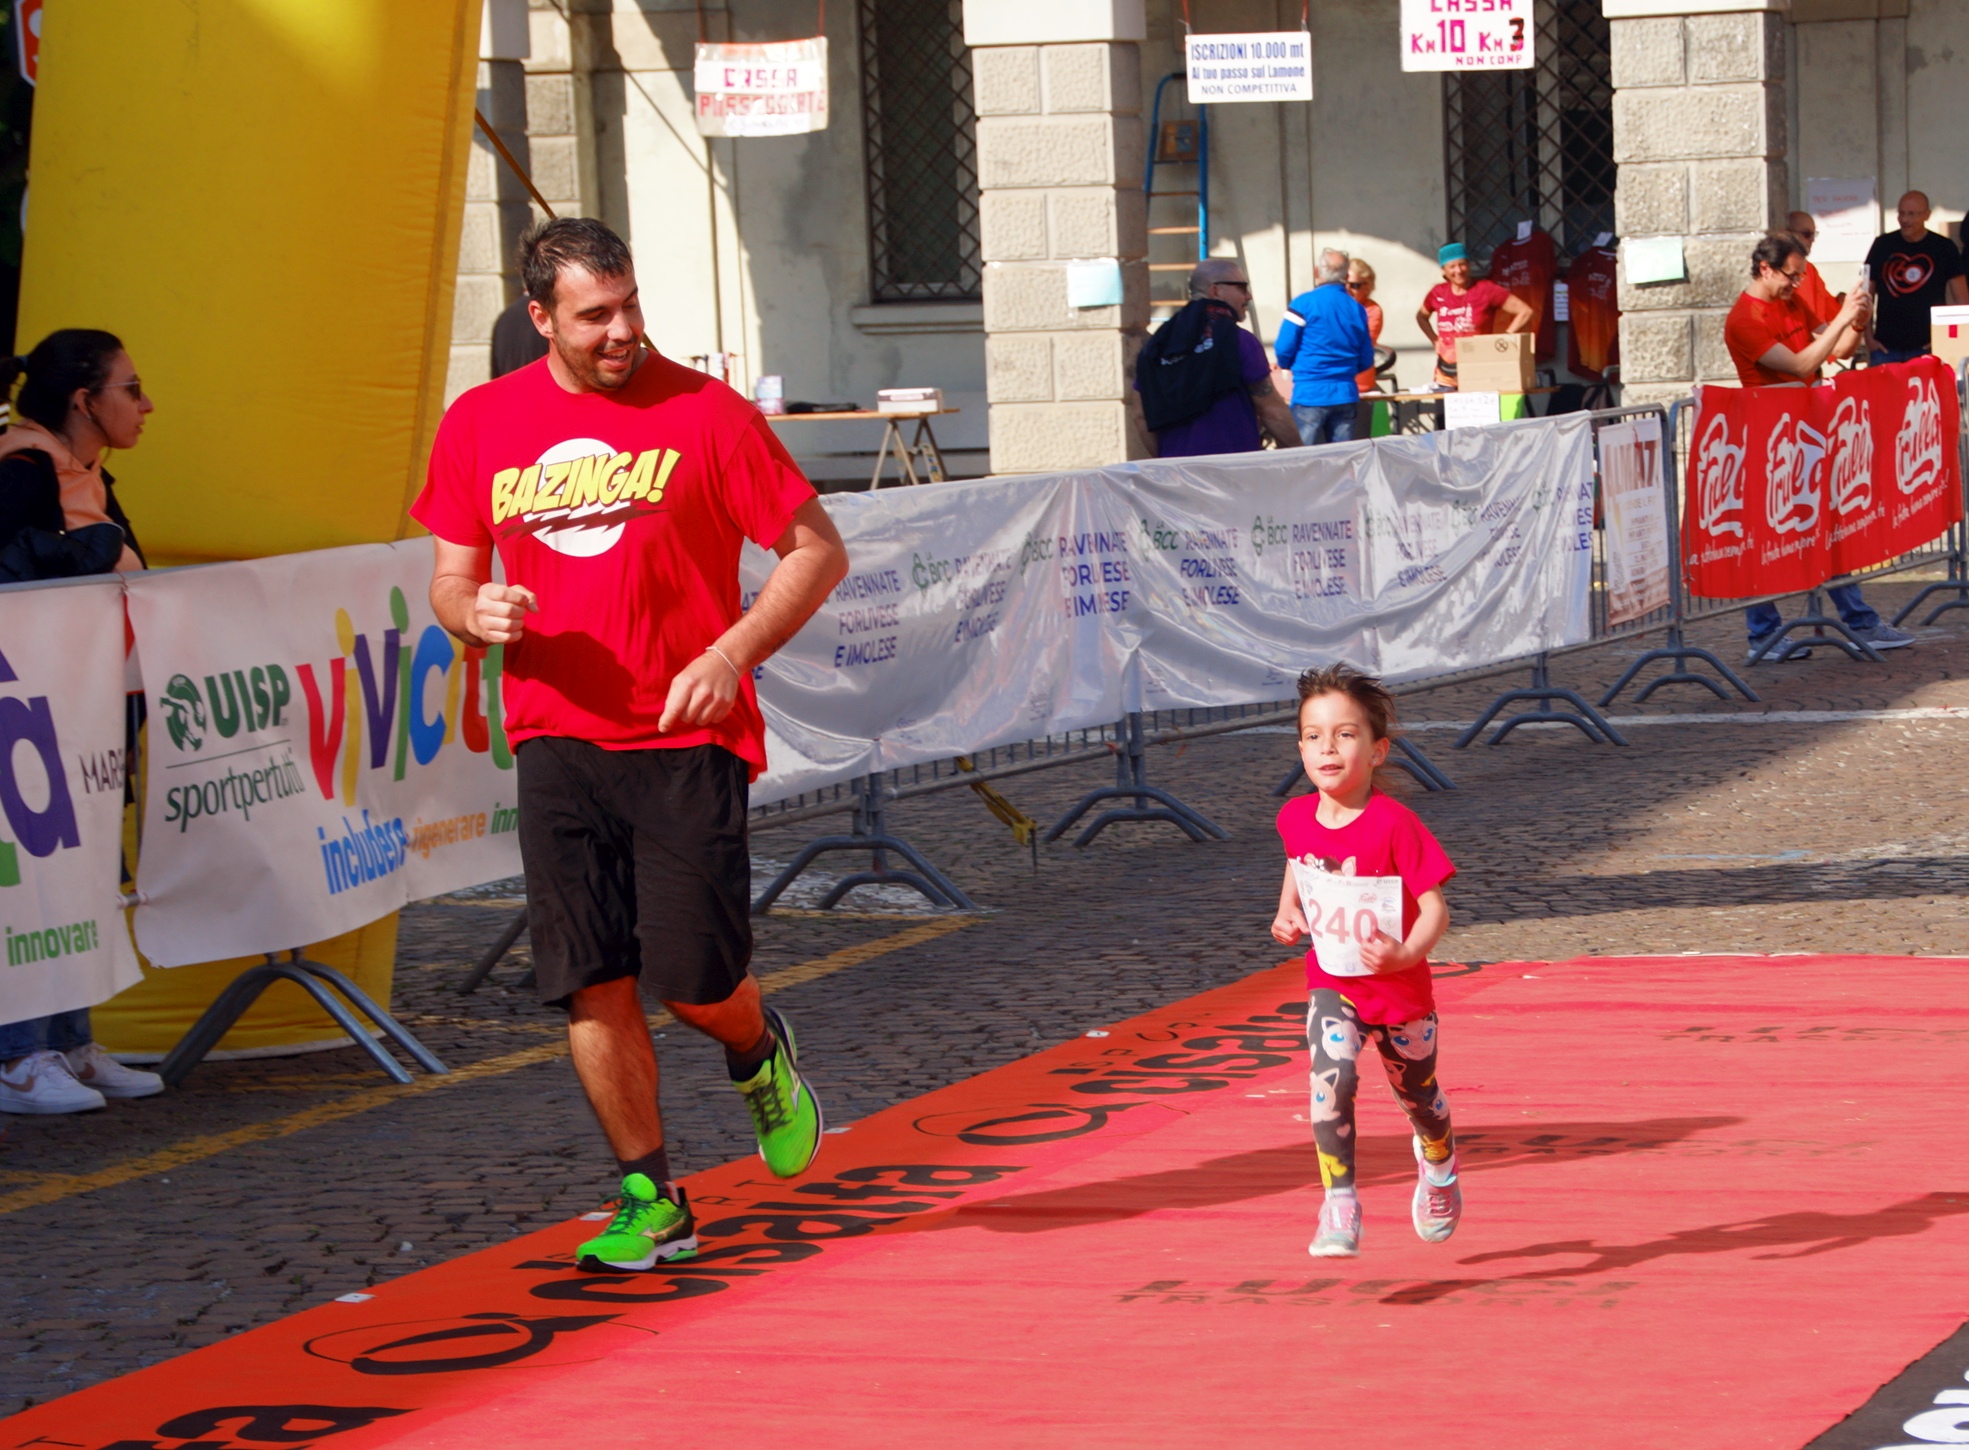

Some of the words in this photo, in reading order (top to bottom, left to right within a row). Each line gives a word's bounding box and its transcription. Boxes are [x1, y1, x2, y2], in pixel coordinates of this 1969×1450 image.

[1429, 0, 1513, 12] CASSA
[1437, 19, 1466, 53] 10
[1508, 17, 1525, 52] 3
[1191, 43, 1247, 60] ISCRIZIONI
[1251, 42, 1287, 59] 10.000
[1290, 43, 1304, 58] mt
[1456, 56, 1484, 65] NON
[1203, 68, 1217, 79] tuo
[1220, 67, 1248, 80] passo
[1251, 65, 1265, 78] sul
[1268, 65, 1305, 78] Lamone
[1201, 85, 1224, 94] NON
[1228, 84, 1297, 94] COMPETITIVA
[491, 448, 682, 526] BAZINGA!
[1153, 531, 1179, 550] BCC
[1267, 524, 1288, 545] BCC
[1292, 520, 1353, 543] RAVENNATE
[928, 559, 952, 584] BCC
[834, 570, 901, 602] RAVENNATE
[838, 604, 899, 636] FORLIVESE
[833, 645, 846, 668] E
[846, 636, 898, 666] IMOLESE
[204, 663, 290, 738] UISP
[165, 747, 305, 833] sportpertutti
[1309, 898, 1378, 944] 240
